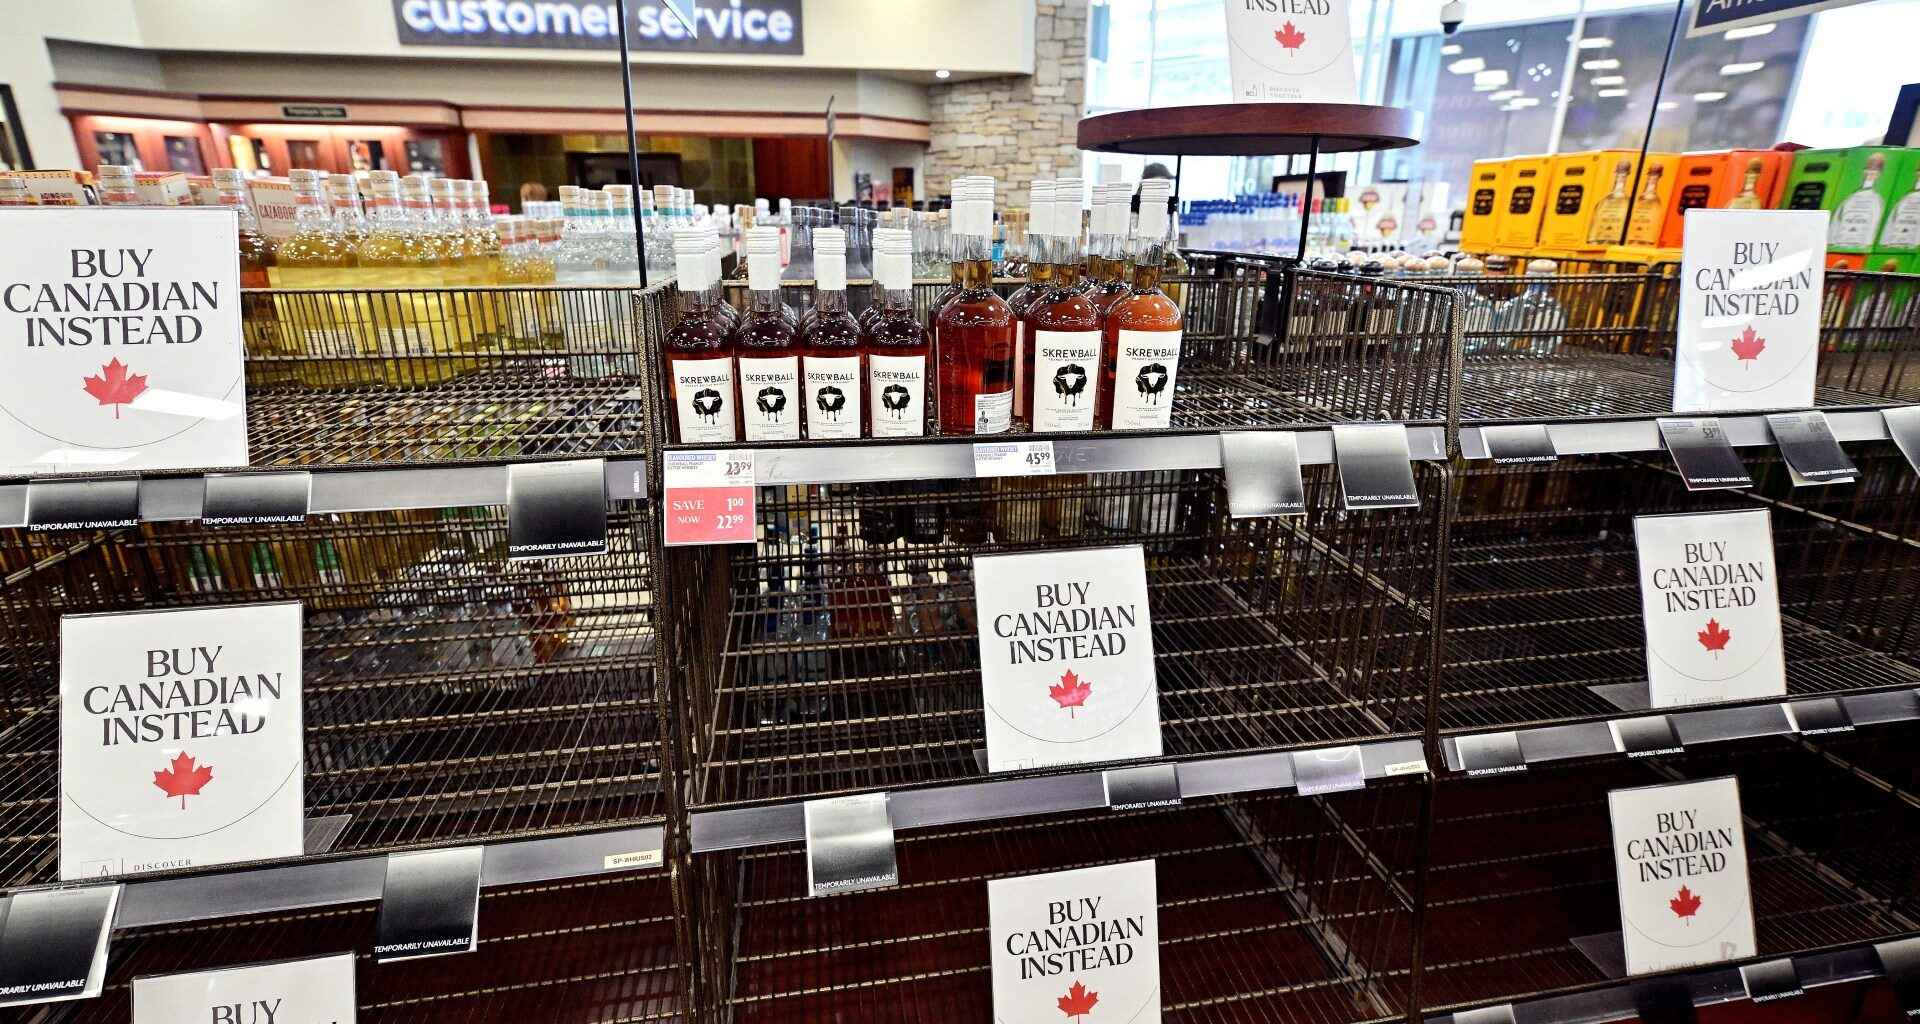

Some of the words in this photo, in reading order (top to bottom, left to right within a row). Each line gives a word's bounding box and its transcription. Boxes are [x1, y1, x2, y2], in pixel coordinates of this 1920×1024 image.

[1245, 0, 1331, 16] INSTEAD
[402, 0, 618, 35] customer
[259, 204, 297, 220] CAZADOR
[1733, 242, 1780, 265] BUY
[70, 249, 154, 278] BUY
[1695, 268, 1812, 291] CANIAN
[3, 281, 219, 314] CANADIAN
[1704, 293, 1800, 317] INSTEAD
[26, 315, 204, 347] INSTEAD
[1042, 348, 1097, 358] SKREWBALL
[1125, 347, 1178, 357] SKREWBALL
[679, 373, 730, 384] SKREWBALL
[745, 372, 794, 382] SKREWBALL
[807, 372, 855, 381] SKREWBALL
[873, 370, 920, 379] SKREWBALL
[1494, 456, 1526, 465] TEMPORARILY
[1526, 455, 1558, 463] UNAVAILABLE
[673, 499, 705, 511] SAVE
[1268, 501, 1304, 509] UNAVAILABLE
[1347, 494, 1381, 502] TEMPORARILY
[1381, 493, 1416, 501] UNAVAILABLE
[29, 520, 84, 532] TEMPORARILY
[85, 518, 139, 529] UNAVAILABLE
[202, 516, 254, 526] TEMPORARILY
[255, 514, 306, 524] UNAVAILABLE
[677, 516, 701, 524] NOW
[509, 543, 558, 552] TEMPORARILY
[557, 539, 605, 549] UNAVAILABLE
[1684, 541, 1727, 564] BUY
[1653, 562, 1764, 590] CANADIAN
[1036, 581, 1091, 608] BUY
[1665, 586, 1757, 613] INSTEAD
[993, 604, 1136, 638] CANADIAN
[1009, 632, 1127, 665] INSTEAD
[147, 645, 223, 678] BUY
[83, 672, 282, 715] CANADIAN
[102, 708, 267, 746] INSTEAD
[1627, 749, 1657, 758] TEMPORARILY
[1656, 747, 1684, 756] UNAVAILABLE
[1467, 768, 1497, 776] TEMPORARILY
[1497, 764, 1528, 773] UNAVAILABLE
[1300, 785, 1332, 793] TEMPORARILY
[1332, 780, 1365, 791] UNAVAILABLE
[1111, 802, 1147, 812] TEMPORARILY
[1146, 798, 1181, 809] UNAVAILABLE
[1656, 809, 1698, 834] BUY
[1627, 828, 1733, 861] CANADIAN
[133, 859, 193, 872] DISCOVER
[1639, 852, 1727, 883] INSTEAD
[814, 878, 855, 891] TEMPORARILY
[855, 873, 896, 885] UNAVAILABLE
[1048, 896, 1102, 925] BUY
[1006, 915, 1144, 956] CANADIAN
[374, 941, 422, 954] TEMPORARILY
[422, 937, 470, 950] UNAVAILABLE
[1020, 943, 1134, 980] INSTEAD
[31, 979, 86, 992] UNAVAILABLE
[211, 998, 282, 1024] BUY
